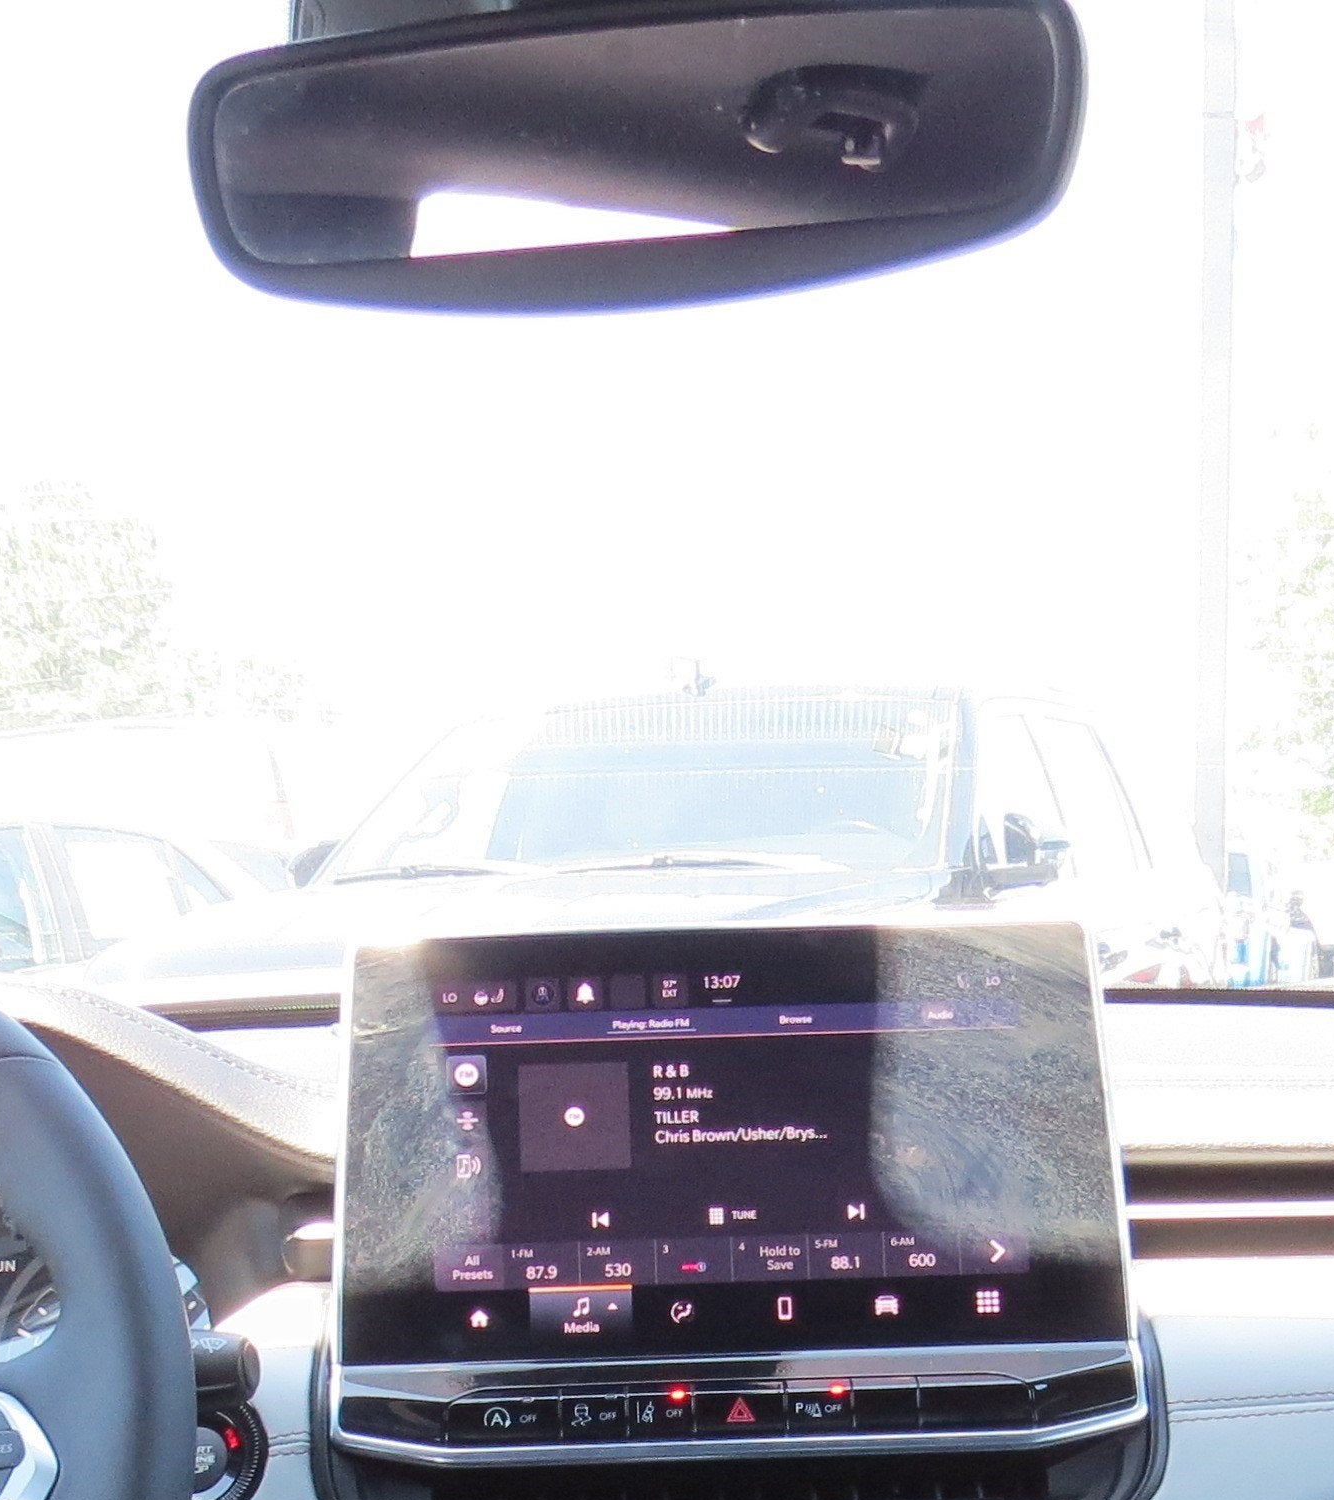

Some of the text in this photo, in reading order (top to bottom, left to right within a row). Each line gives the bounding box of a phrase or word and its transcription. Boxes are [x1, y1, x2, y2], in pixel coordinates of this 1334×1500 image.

[703, 975, 741, 989] 13:07
[442, 992, 457, 1004] LO
[779, 1014, 812, 1026] Browse
[927, 1010, 954, 1021] Audio
[490, 1023, 522, 1034] Source
[612, 1017, 690, 1031] Playing: Radio FM
[652, 1064, 690, 1079] R & B
[652, 1087, 714, 1101] 99.1 MHz
[654, 1110, 700, 1125] TILLER
[655, 1125, 828, 1144] Chris Brown/Usher/Brys...
[731, 1209, 757, 1221] TUNE
[738, 1242, 746, 1252] 4
[815, 1238, 838, 1249] 5-FM
[890, 1237, 915, 1248] 6-AM
[511, 1248, 534, 1259] 1-FM
[586, 1246, 611, 1257] 2-AM
[662, 1244, 669, 1255] 3
[759, 1245, 801, 1258] Hold to
[465, 1254, 480, 1267] All
[767, 1259, 794, 1272] Save
[831, 1255, 861, 1270] 88.1
[908, 1253, 936, 1268] 600
[452, 1268, 494, 1282] Presets
[525, 1265, 558, 1281] 87.9
[604, 1262, 632, 1279] 530
[564, 1321, 600, 1334] Media
[667, 1408, 683, 1419] OFF
[824, 1404, 842, 1414] OFF
[519, 1413, 538, 1424] OFF
[599, 1411, 618, 1422] OFF
